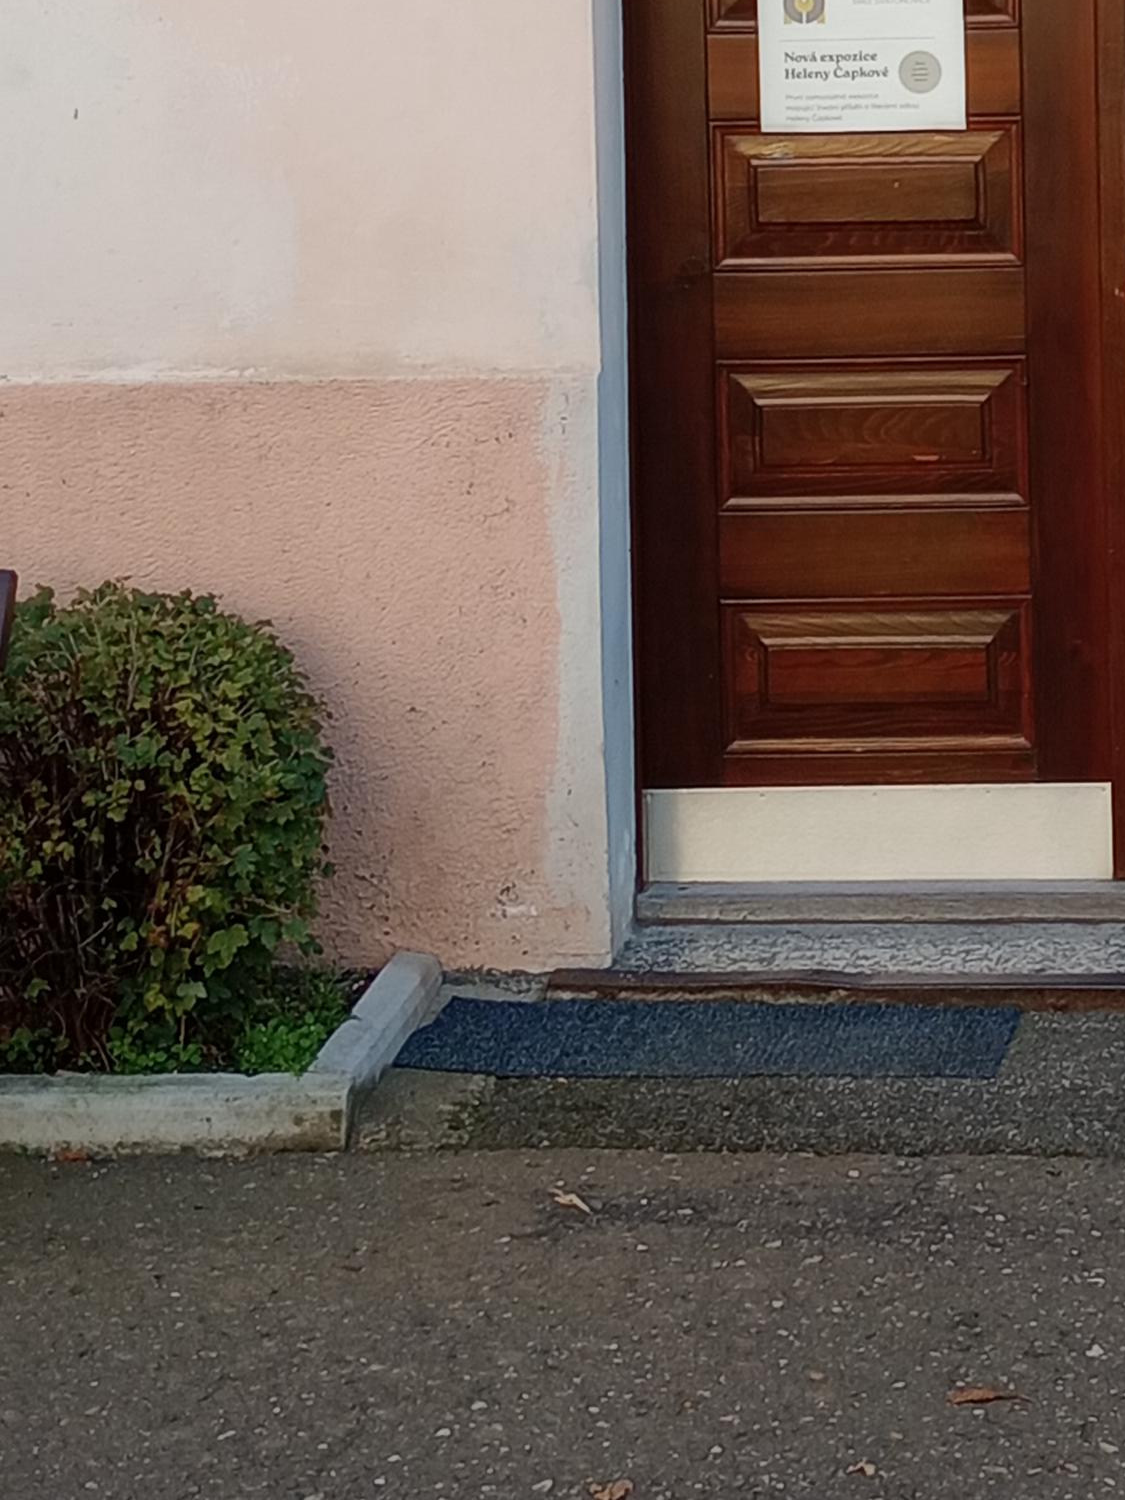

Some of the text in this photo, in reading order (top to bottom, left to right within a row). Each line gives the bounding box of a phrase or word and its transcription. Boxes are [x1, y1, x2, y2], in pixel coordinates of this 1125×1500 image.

[783, 50, 878, 67] Nová expozice
[784, 64, 889, 81] Heleny Čapkové
